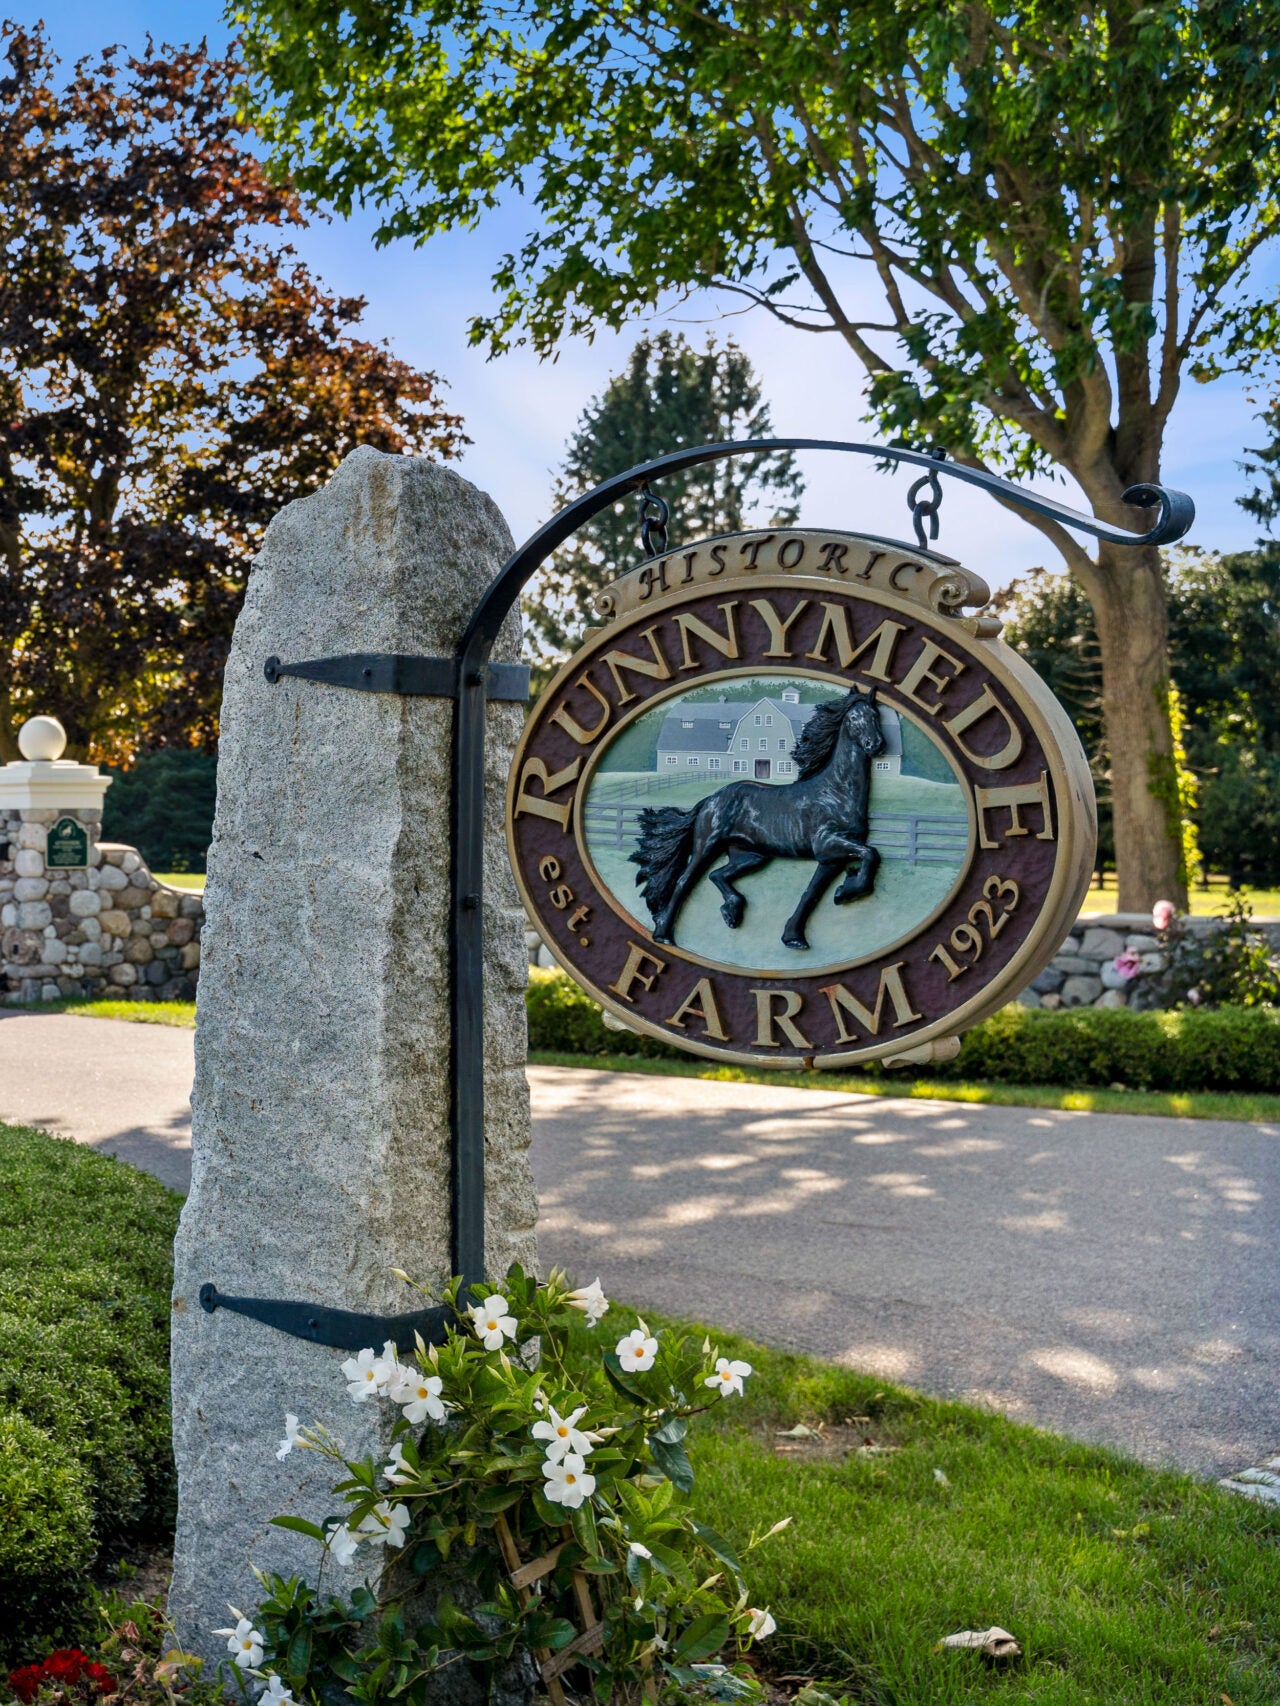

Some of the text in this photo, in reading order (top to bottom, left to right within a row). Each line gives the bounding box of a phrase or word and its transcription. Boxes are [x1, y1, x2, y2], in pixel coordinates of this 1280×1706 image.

[638, 534, 923, 600] HISTORIC
[514, 599, 1055, 850] RUNNYMEDE
[538, 855, 593, 948] est.
[928, 875, 1020, 982] 1923
[608, 940, 922, 1049] FARM
